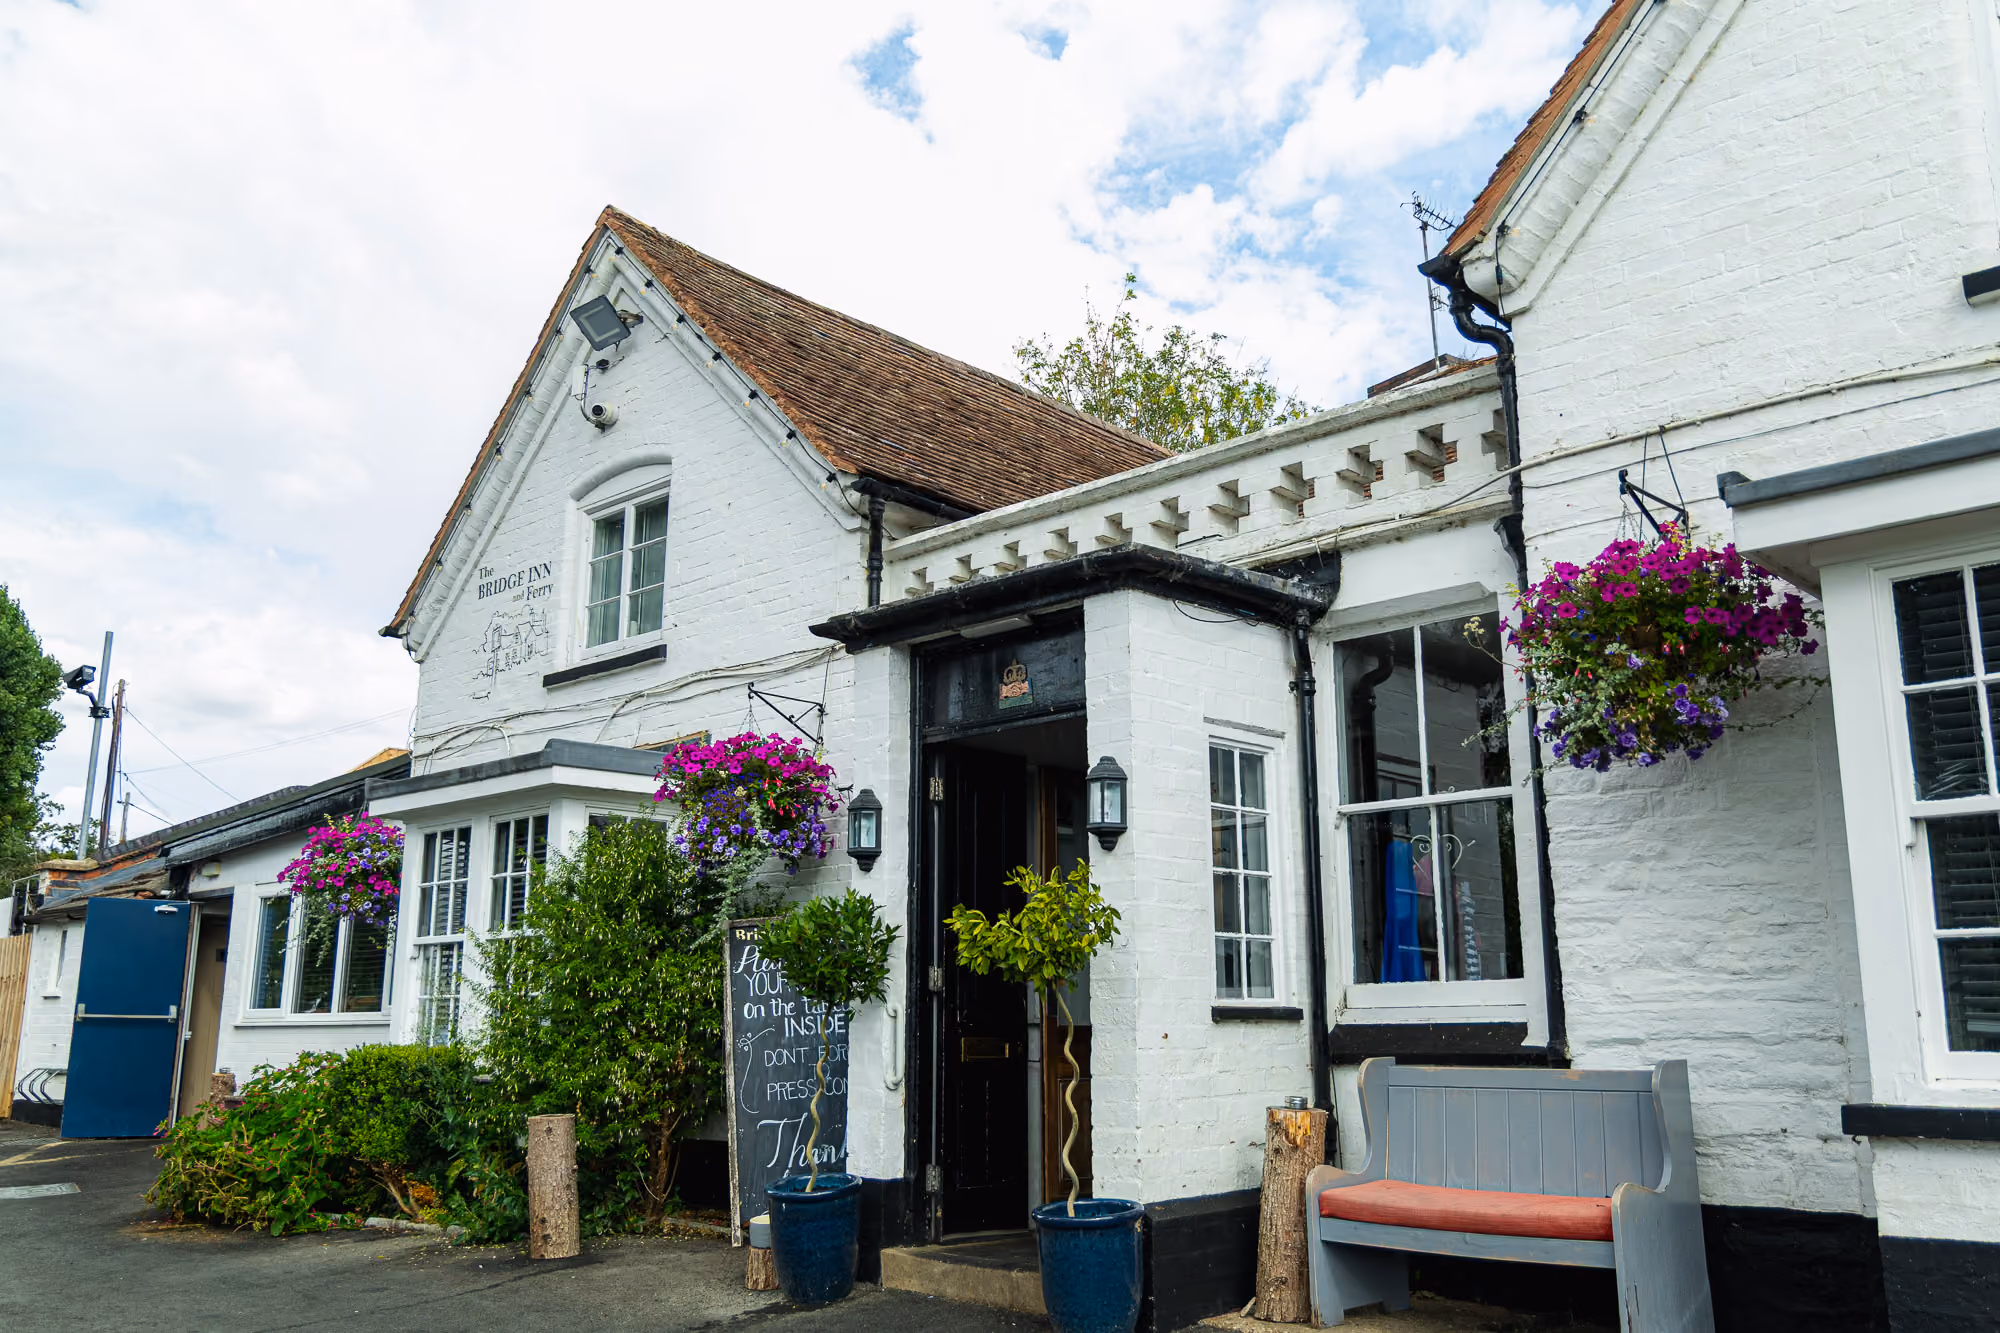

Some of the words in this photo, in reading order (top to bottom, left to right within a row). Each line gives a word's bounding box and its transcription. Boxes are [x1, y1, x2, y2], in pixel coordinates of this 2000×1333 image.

[478, 570, 525, 600] BRIDGE
[528, 561, 552, 583] INN
[479, 566, 495, 580] The
[527, 583, 554, 601] Ferry
[743, 1002, 766, 1019] on
[769, 997, 797, 1017] the
[784, 1014, 846, 1037] INSIDE
[764, 1047, 809, 1067] DONT
[767, 1078, 818, 1102] PRESS
